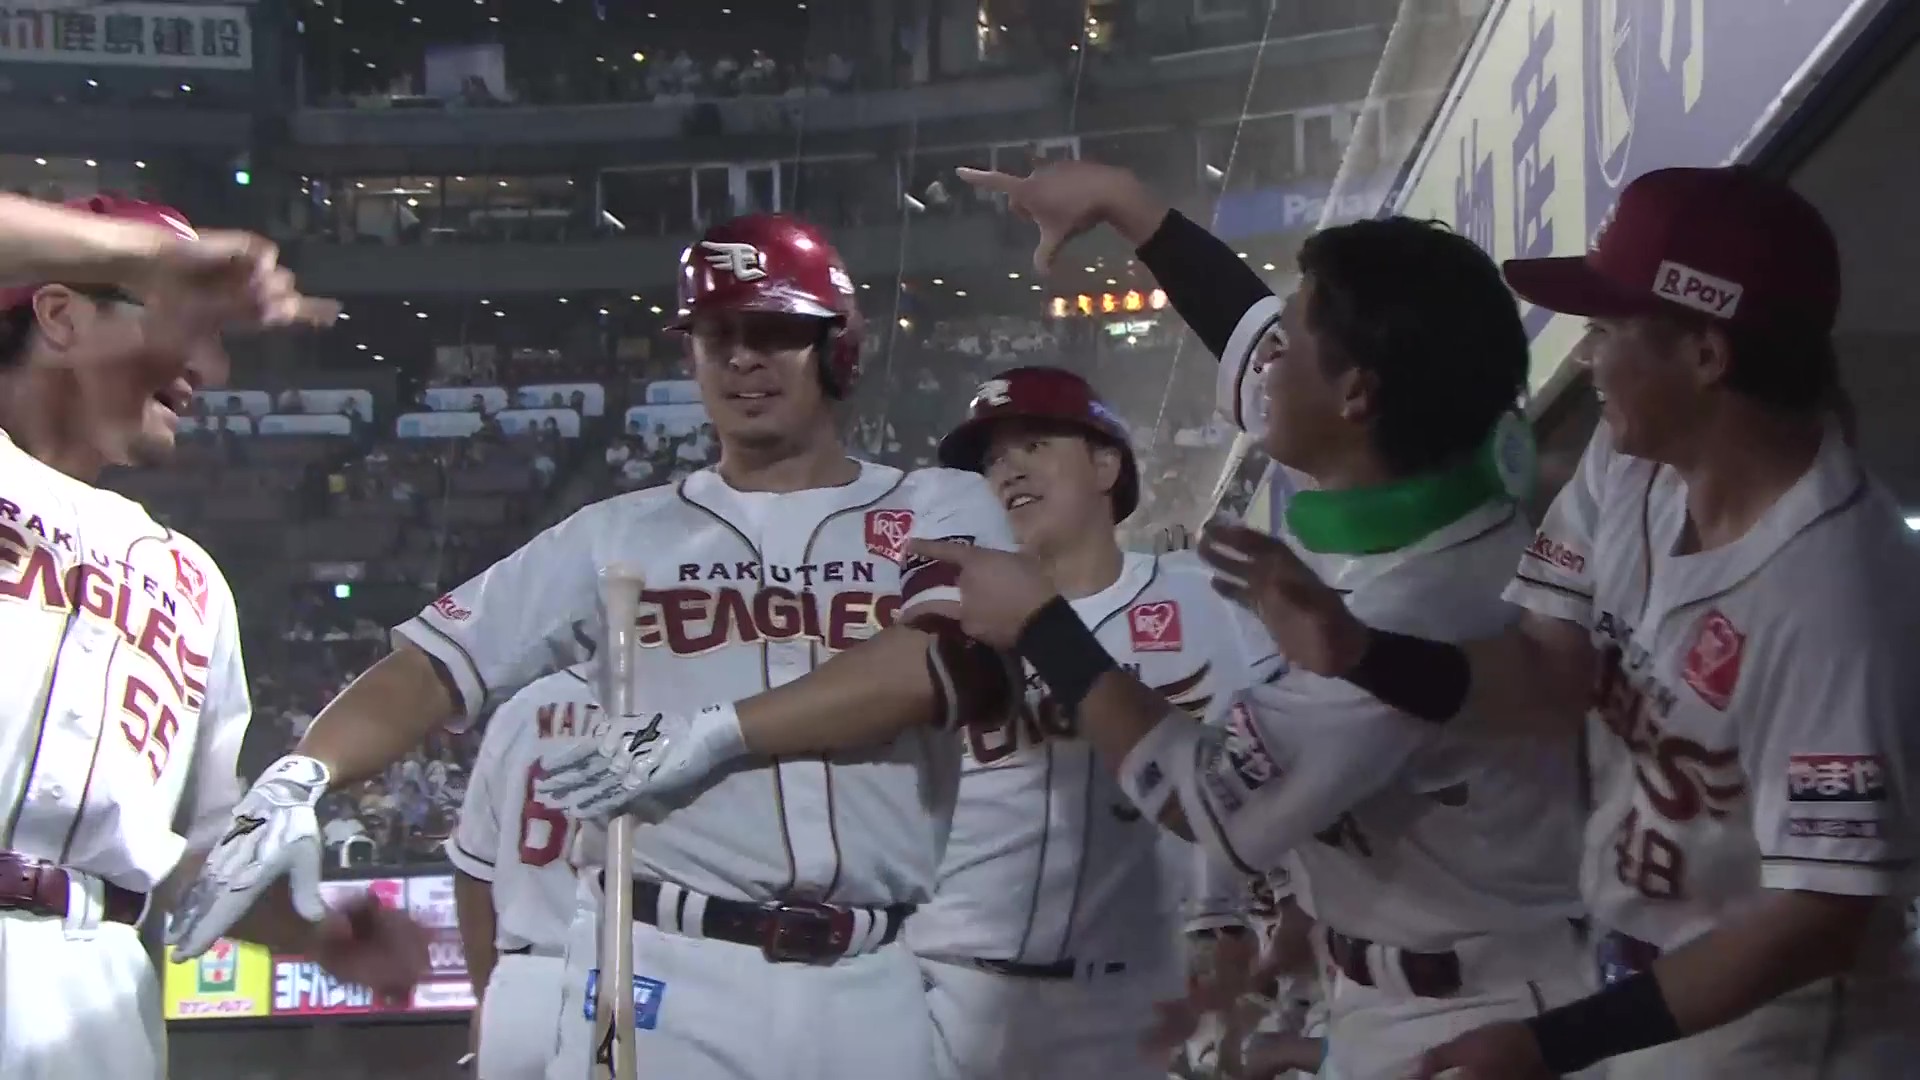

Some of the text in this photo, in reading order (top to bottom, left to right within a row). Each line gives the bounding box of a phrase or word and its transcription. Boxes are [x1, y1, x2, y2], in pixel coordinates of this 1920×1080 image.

[1683, 276, 1735, 312] Pay
[679, 560, 874, 587] RAKUTEN
[120, 674, 180, 790] 55
[537, 702, 600, 739] WAT
[1789, 760, 1882, 796] やまや
[518, 755, 583, 869] 6
